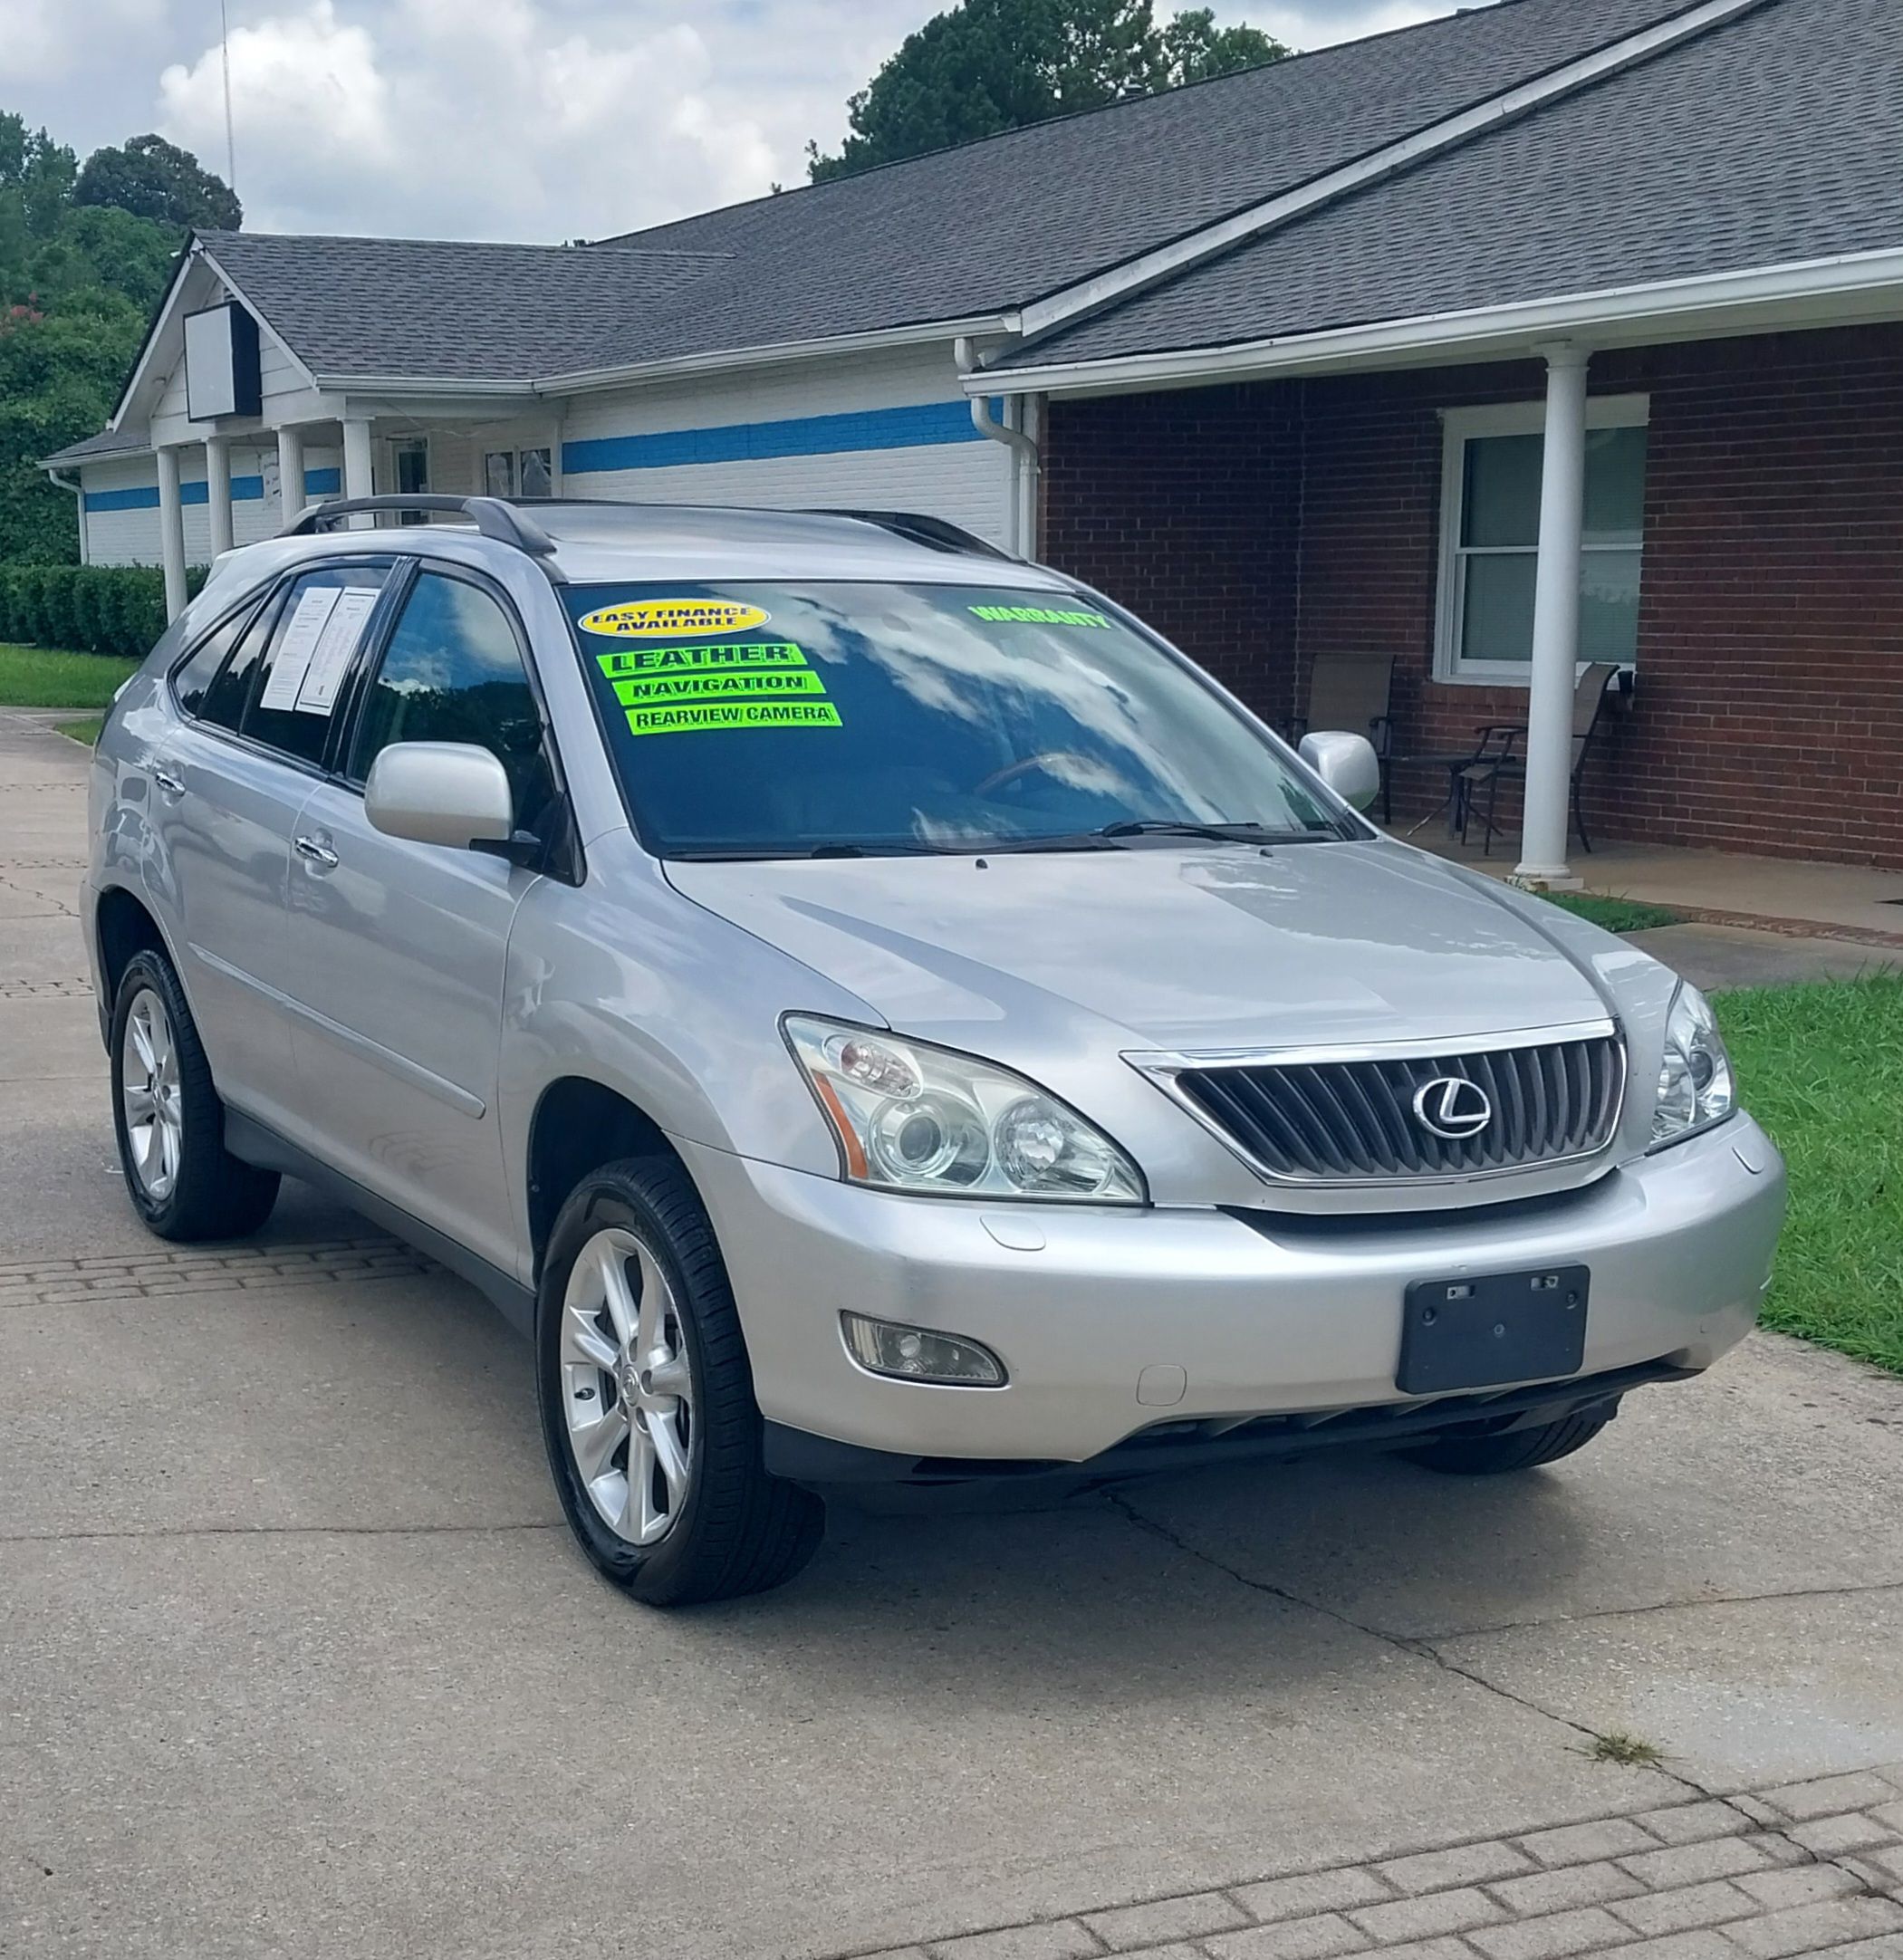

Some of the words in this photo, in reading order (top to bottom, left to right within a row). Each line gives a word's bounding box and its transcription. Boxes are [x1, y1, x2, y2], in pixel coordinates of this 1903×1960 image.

[591, 610, 649, 623] EASY
[656, 608, 751, 619] FINANCE
[617, 618, 737, 632] AVAILABLE
[967, 606, 1111, 629] WARRANTY
[611, 646, 792, 672] LEATHER
[633, 676, 804, 697] NAVIGATION
[636, 708, 741, 727] REARVIEW
[746, 706, 831, 722] CAMERA
